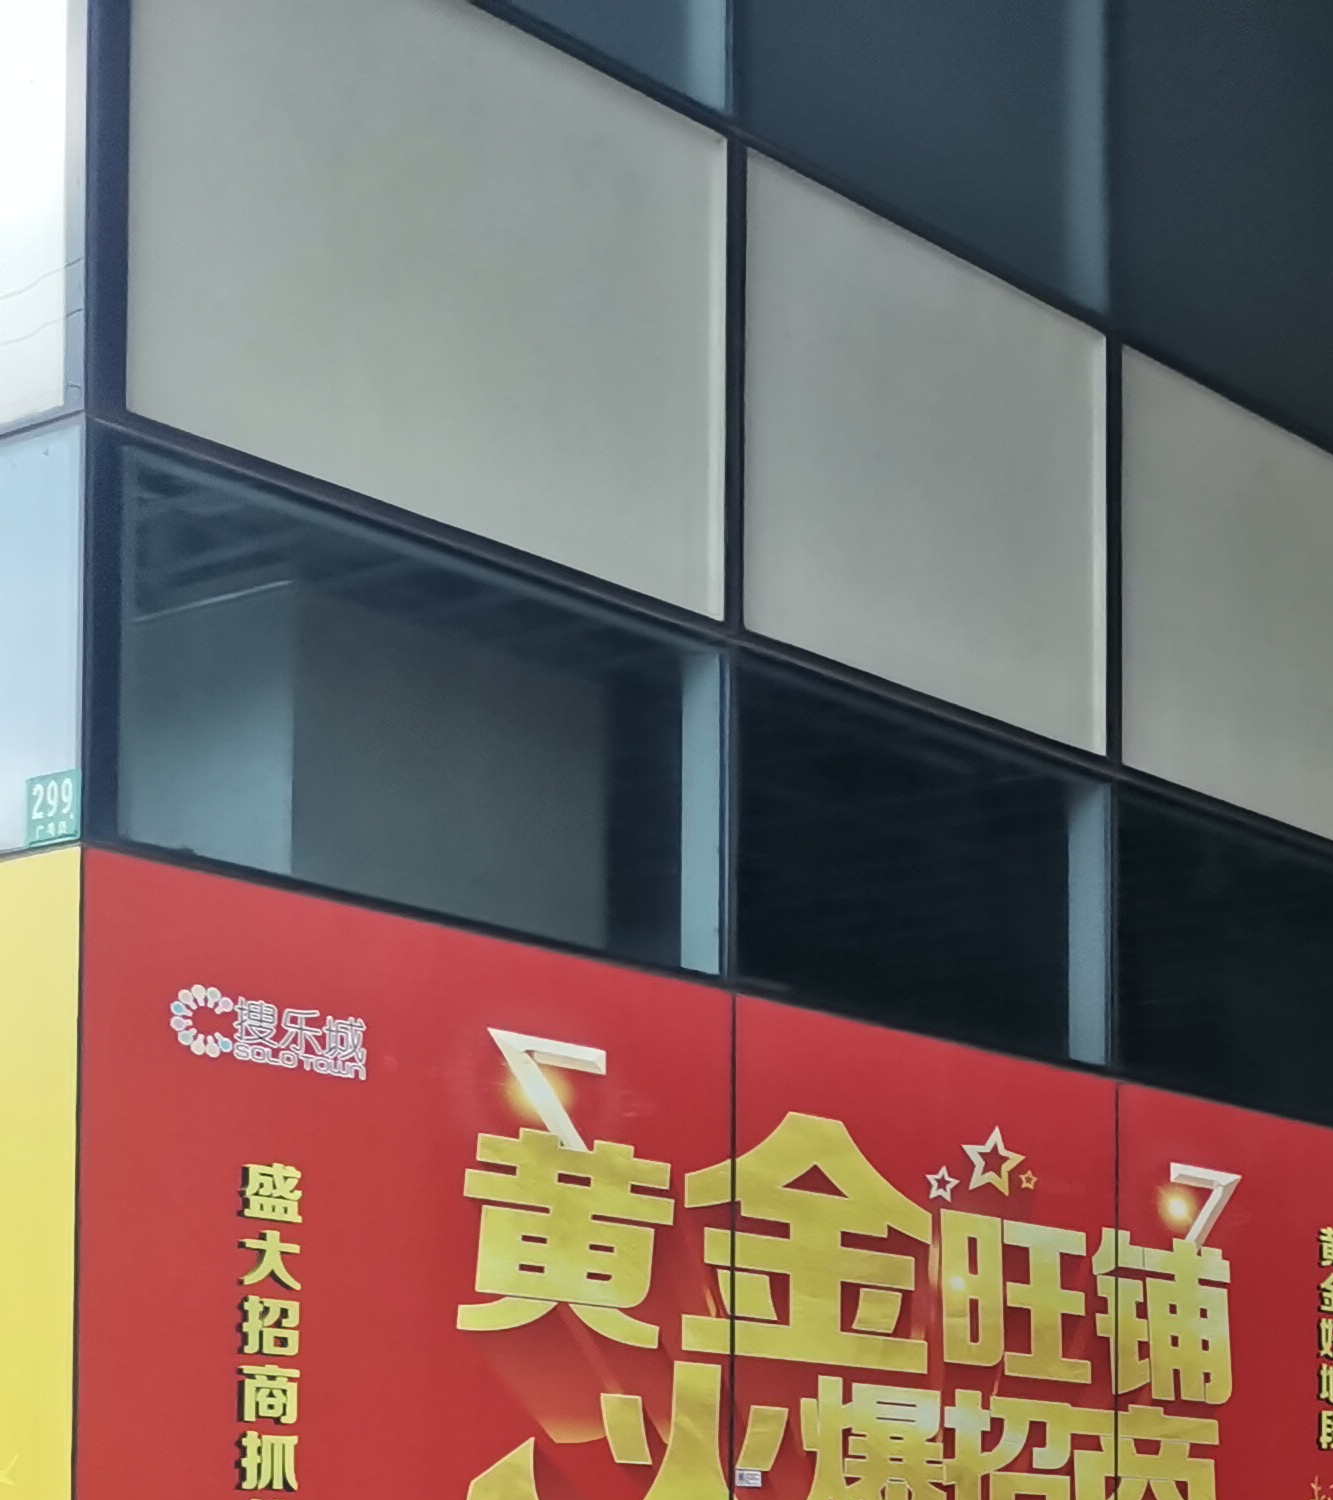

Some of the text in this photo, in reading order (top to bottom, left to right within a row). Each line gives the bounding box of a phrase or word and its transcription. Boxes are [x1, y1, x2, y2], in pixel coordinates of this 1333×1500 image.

[31, 777, 74, 820] 299
[233, 996, 367, 1064] 搜乐城
[233, 1042, 299, 1069] SOLO
[456, 1111, 1232, 1404] 黄金旺铺
